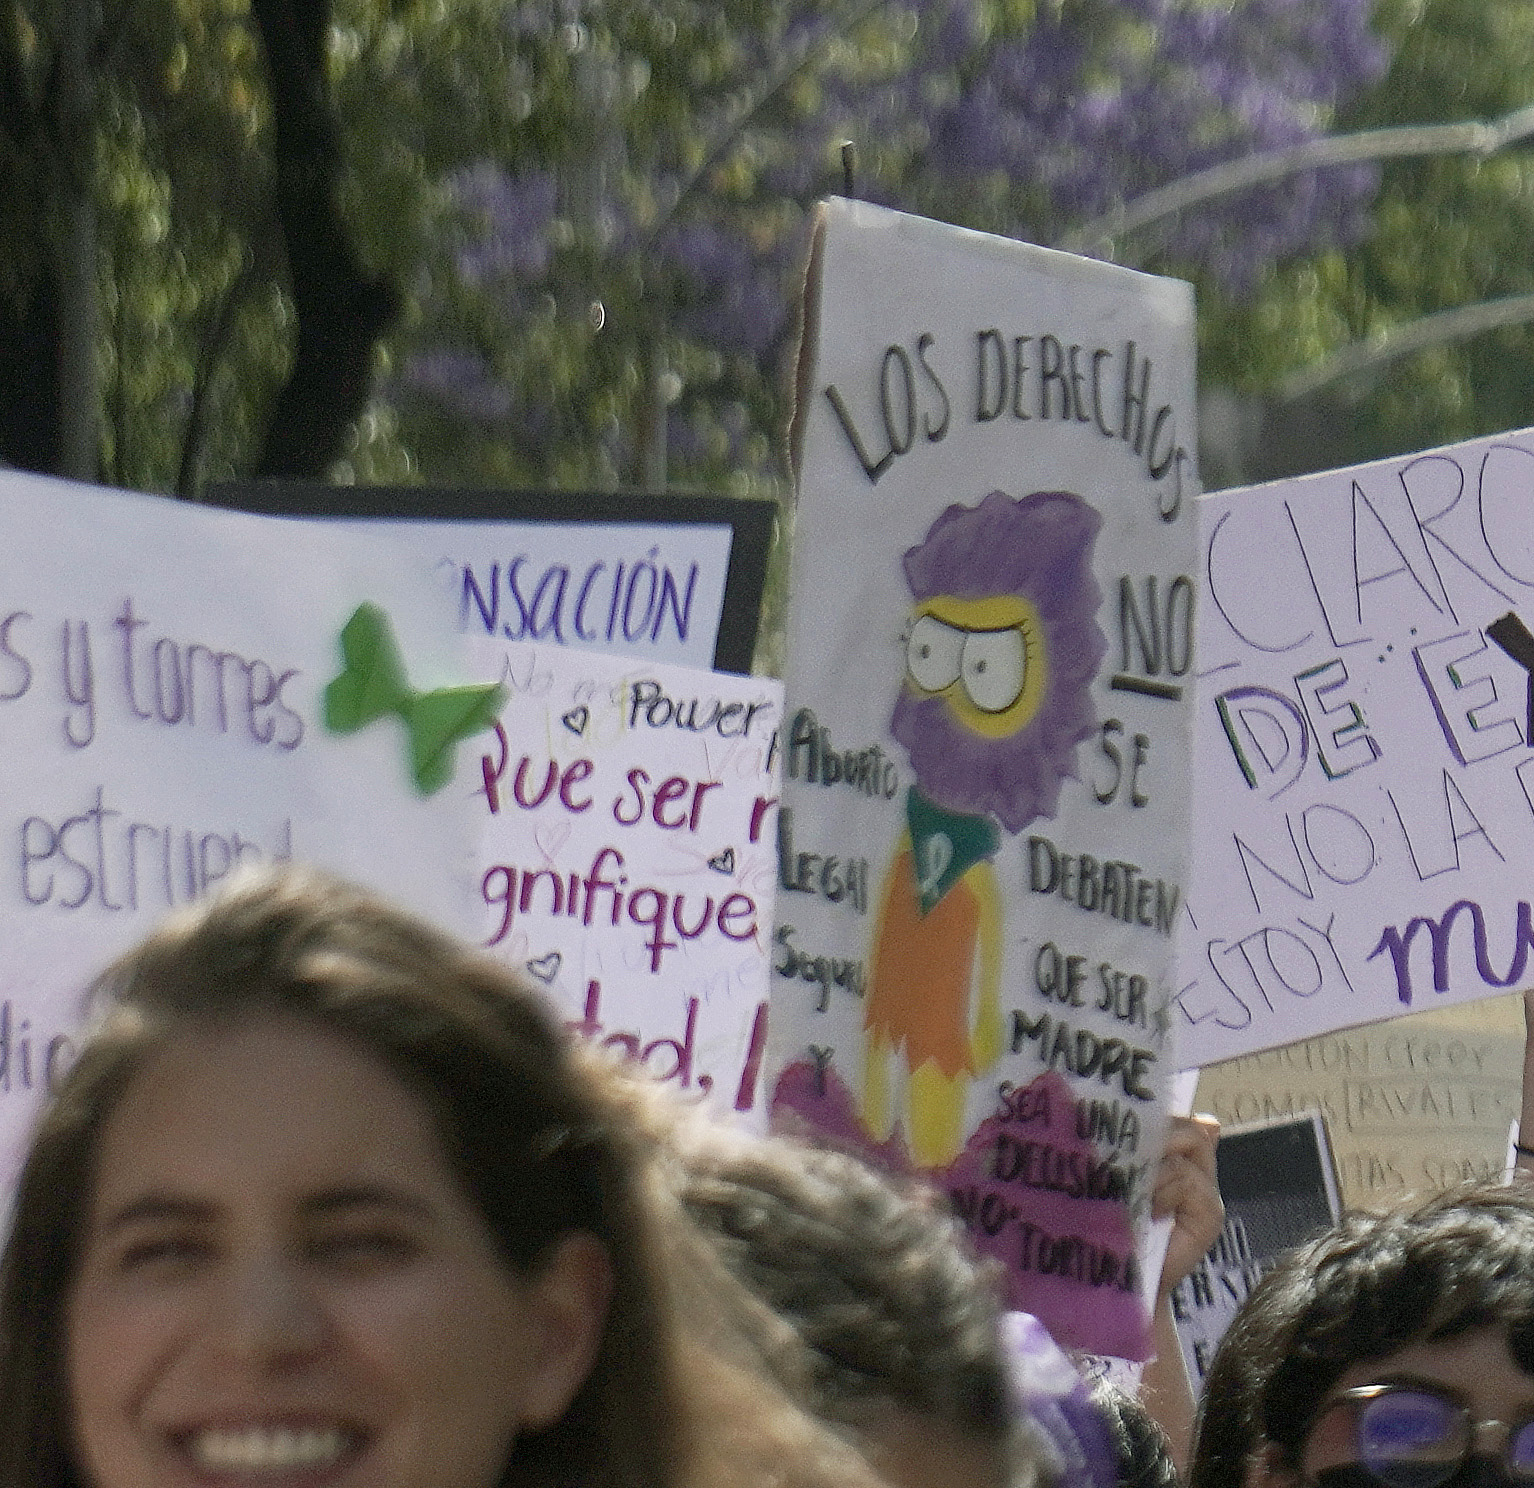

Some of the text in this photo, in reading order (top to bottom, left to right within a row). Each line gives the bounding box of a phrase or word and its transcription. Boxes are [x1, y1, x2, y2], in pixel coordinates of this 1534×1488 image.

[825, 327, 1188, 523] LOS DERECHOS
[1118, 574, 1195, 676] NO
[62, 618, 96, 750] y
[629, 680, 774, 738] Power
[1215, 655, 1384, 801] DE
[612, 767, 723, 832] ser
[1092, 718, 1151, 809] SE
[21, 785, 293, 910] estrue
[1029, 835, 1181, 938] DEBATEN
[1234, 803, 1376, 913] NO
[1387, 766, 1506, 882] LA
[482, 847, 758, 974] gnifique
[1035, 941, 1149, 1030] QUE SER
[1173, 911, 1355, 1034] ESTOY
[1011, 1008, 1157, 1101] MADRE
[1074, 1097, 1141, 1155] UNA
